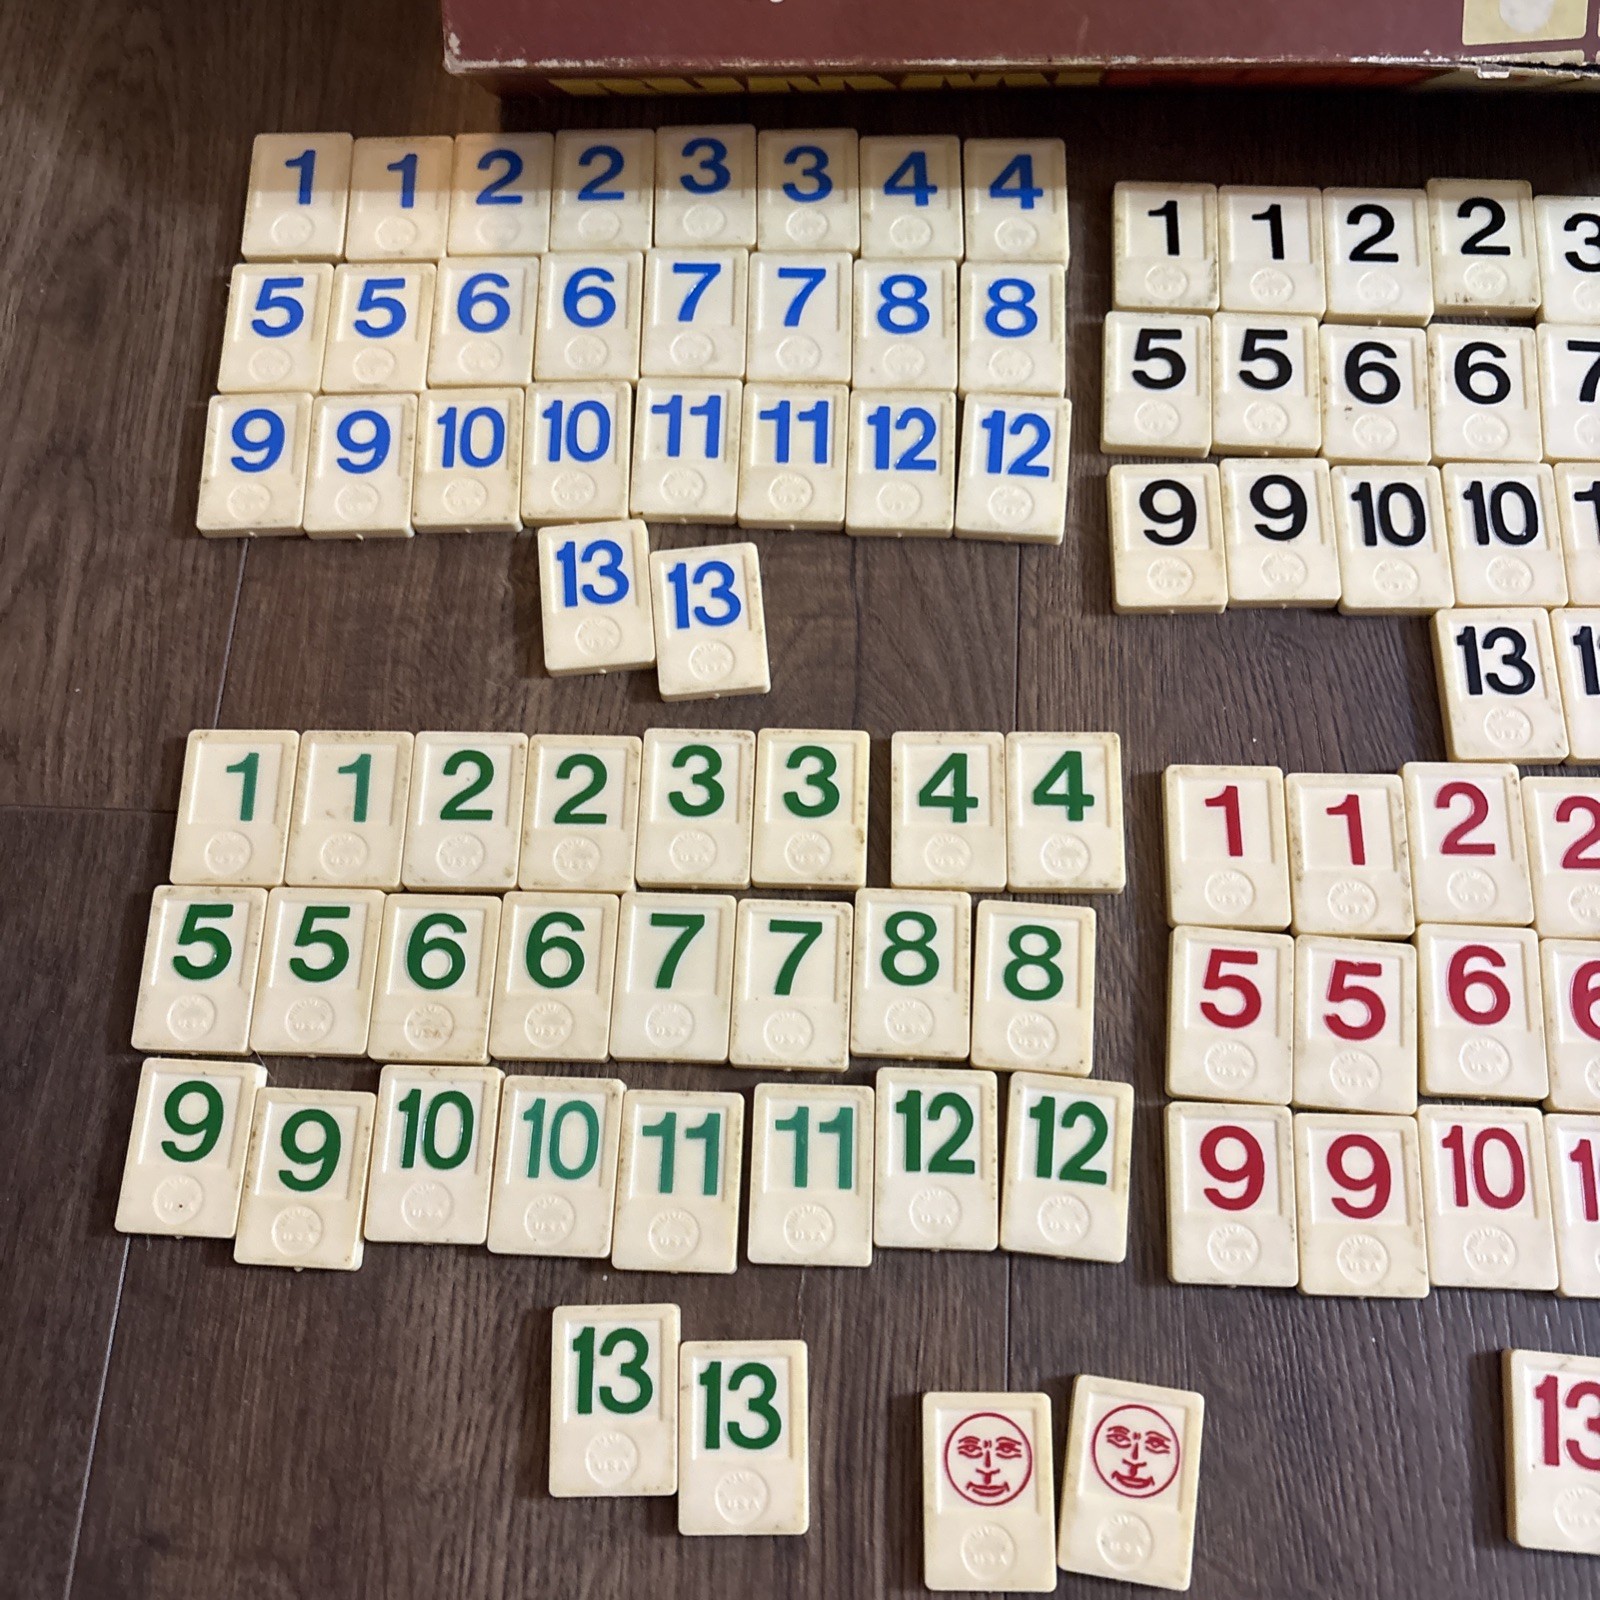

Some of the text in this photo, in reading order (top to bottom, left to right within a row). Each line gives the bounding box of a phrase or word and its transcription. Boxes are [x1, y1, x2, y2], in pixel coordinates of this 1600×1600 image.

[285, 150, 315, 205] 1
[389, 154, 417, 208] 1
[475, 149, 523, 205] 2
[576, 146, 625, 201] 2
[680, 138, 730, 194] 3
[782, 146, 832, 203] 3
[882, 152, 938, 207] 4
[988, 154, 1044, 210] 4
[1146, 200, 1180, 256] 1
[1250, 203, 1285, 260] 1
[1345, 203, 1399, 263] 2
[1456, 195, 1511, 256] 2
[1564, 213, 1600, 272] 3
[250, 277, 304, 338] 5
[353, 278, 406, 338] 5
[456, 272, 510, 333] 6
[562, 267, 616, 328] 6
[671, 262, 721, 322] 7
[776, 267, 827, 327] 7
[875, 274, 930, 335] 8
[983, 278, 1038, 338] 8
[1130, 328, 1187, 390] 5
[1237, 328, 1293, 391] 5
[1343, 341, 1401, 405] 6
[1453, 341, 1511, 405] 6
[1567, 340, 1600, 402] 7
[230, 408, 285, 473] 9
[335, 410, 391, 474] 9
[436, 407, 505, 468] 10
[541, 400, 611, 462] 10
[650, 394, 721, 459] 11
[758, 400, 829, 464] 11
[866, 405, 937, 471] 12
[980, 409, 1051, 478] 12
[1138, 479, 1197, 546] 9
[1248, 474, 1308, 542] 9
[1349, 481, 1426, 547] 10
[1461, 480, 1539, 546] 10
[555, 539, 630, 608] 13
[666, 560, 742, 629] 13
[1455, 625, 1536, 696] 13
[1573, 626, 1600, 695] 1
[226, 753, 258, 821] 1
[338, 754, 371, 821] 1
[439, 750, 494, 820] 2
[553, 754, 607, 824] 2
[668, 745, 725, 817] 3
[782, 746, 840, 818] 3
[918, 753, 978, 823] 4
[1032, 751, 1094, 821] 4
[1204, 785, 1243, 857] 1
[1325, 794, 1365, 865] 1
[1435, 782, 1495, 855] 2
[1554, 796, 1600, 869] 2
[172, 904, 233, 980] 5
[289, 906, 349, 982] 5
[406, 913, 467, 990] 6
[524, 912, 585, 988] 6
[650, 913, 705, 988] 7
[768, 920, 822, 995] 7
[880, 911, 939, 986] 8
[1003, 925, 1063, 1001] 8
[1199, 949, 1262, 1029] 5
[1324, 960, 1386, 1041] 5
[1447, 945, 1511, 1025] 6
[160, 1080, 224, 1162] 9
[278, 1109, 341, 1192] 9
[397, 1089, 474, 1170] 10
[522, 1098, 599, 1179] 10
[641, 1112, 720, 1195] 11
[774, 1107, 853, 1189] 11
[895, 1090, 975, 1174] 12
[1028, 1096, 1108, 1185] 12
[1199, 1125, 1265, 1211] 9
[1325, 1134, 1391, 1219] 9
[1441, 1125, 1525, 1209] 10
[1570, 1139, 1600, 1221] 1
[571, 1327, 653, 1414] 13
[698, 1361, 782, 1450] 13
[1535, 1375, 1600, 1471] 13
